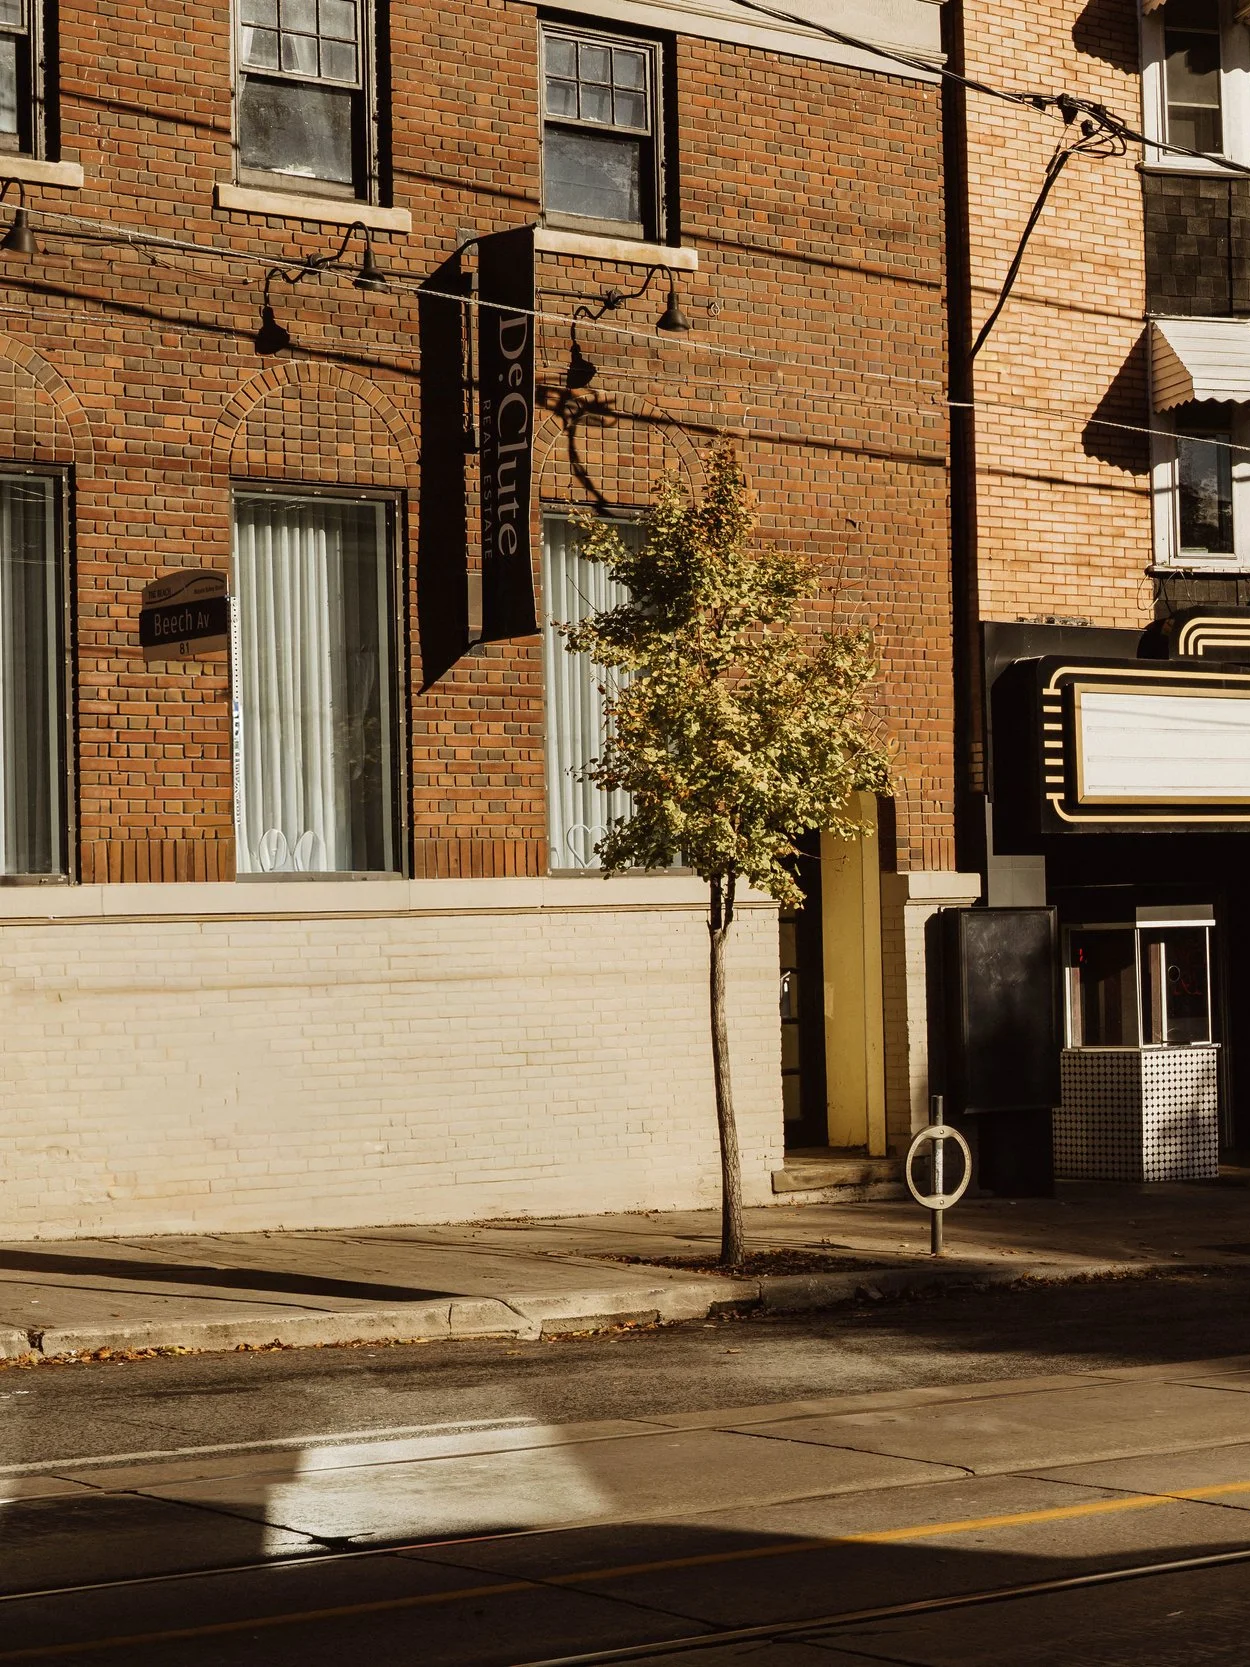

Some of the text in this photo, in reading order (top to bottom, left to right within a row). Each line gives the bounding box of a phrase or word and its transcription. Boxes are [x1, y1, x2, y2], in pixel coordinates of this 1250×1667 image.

[483, 400, 493, 559] REAL ESTATE
[154, 609, 210, 637] Beech Av
[179, 641, 190, 655] 81
